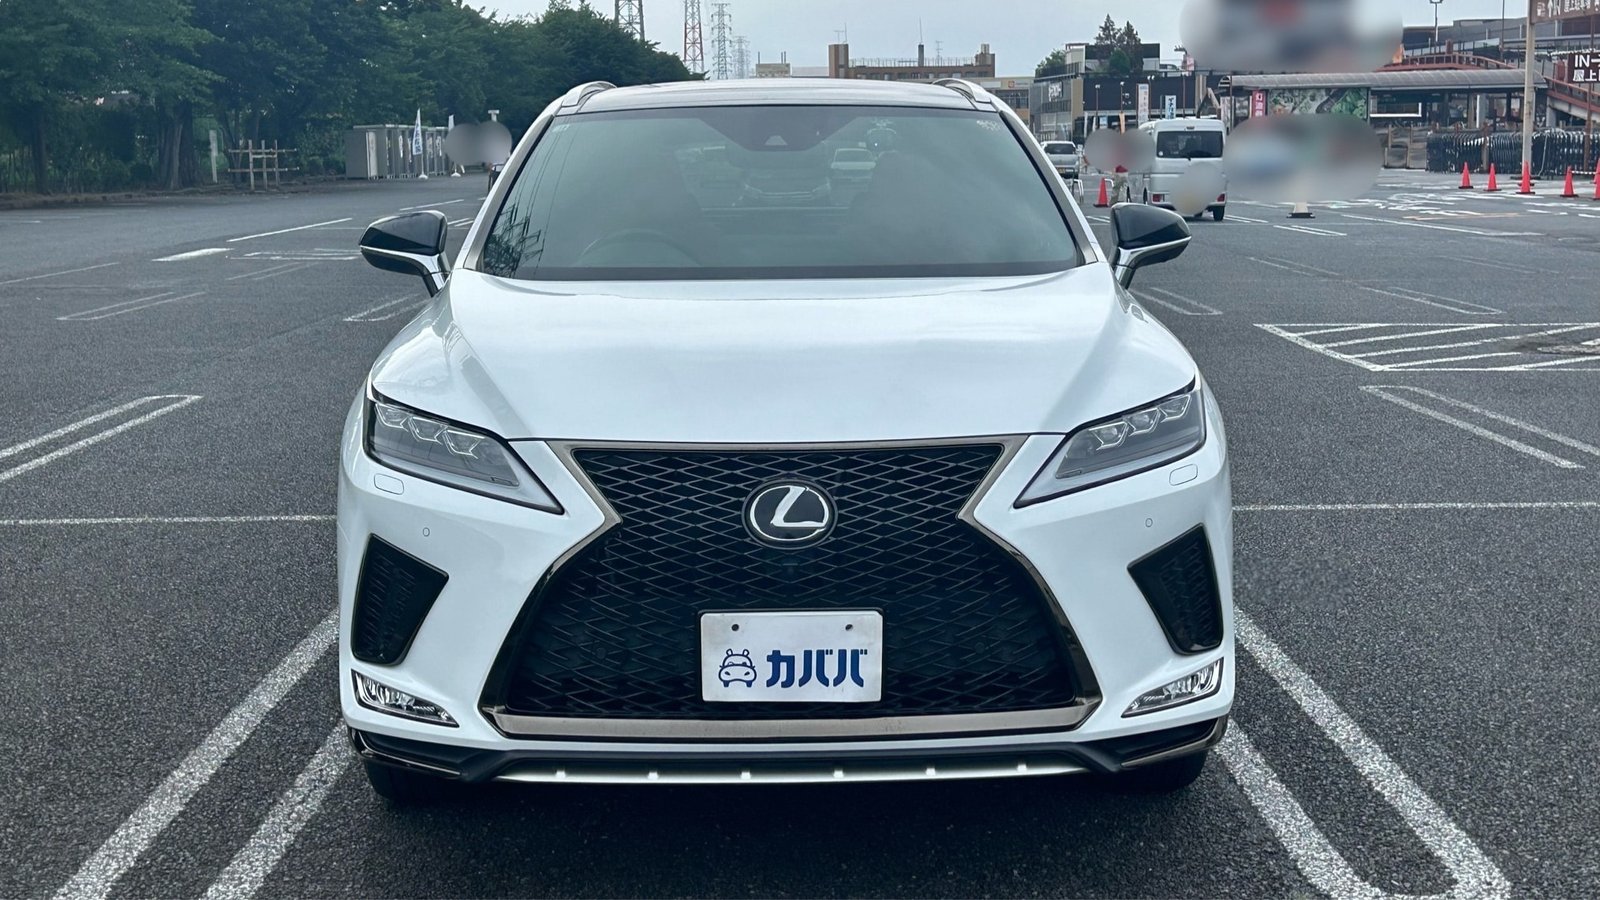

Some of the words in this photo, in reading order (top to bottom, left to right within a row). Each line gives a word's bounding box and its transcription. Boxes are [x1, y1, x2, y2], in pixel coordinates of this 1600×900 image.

[1573, 69, 1600, 82] 屋上
[766, 649, 868, 689] カババ
